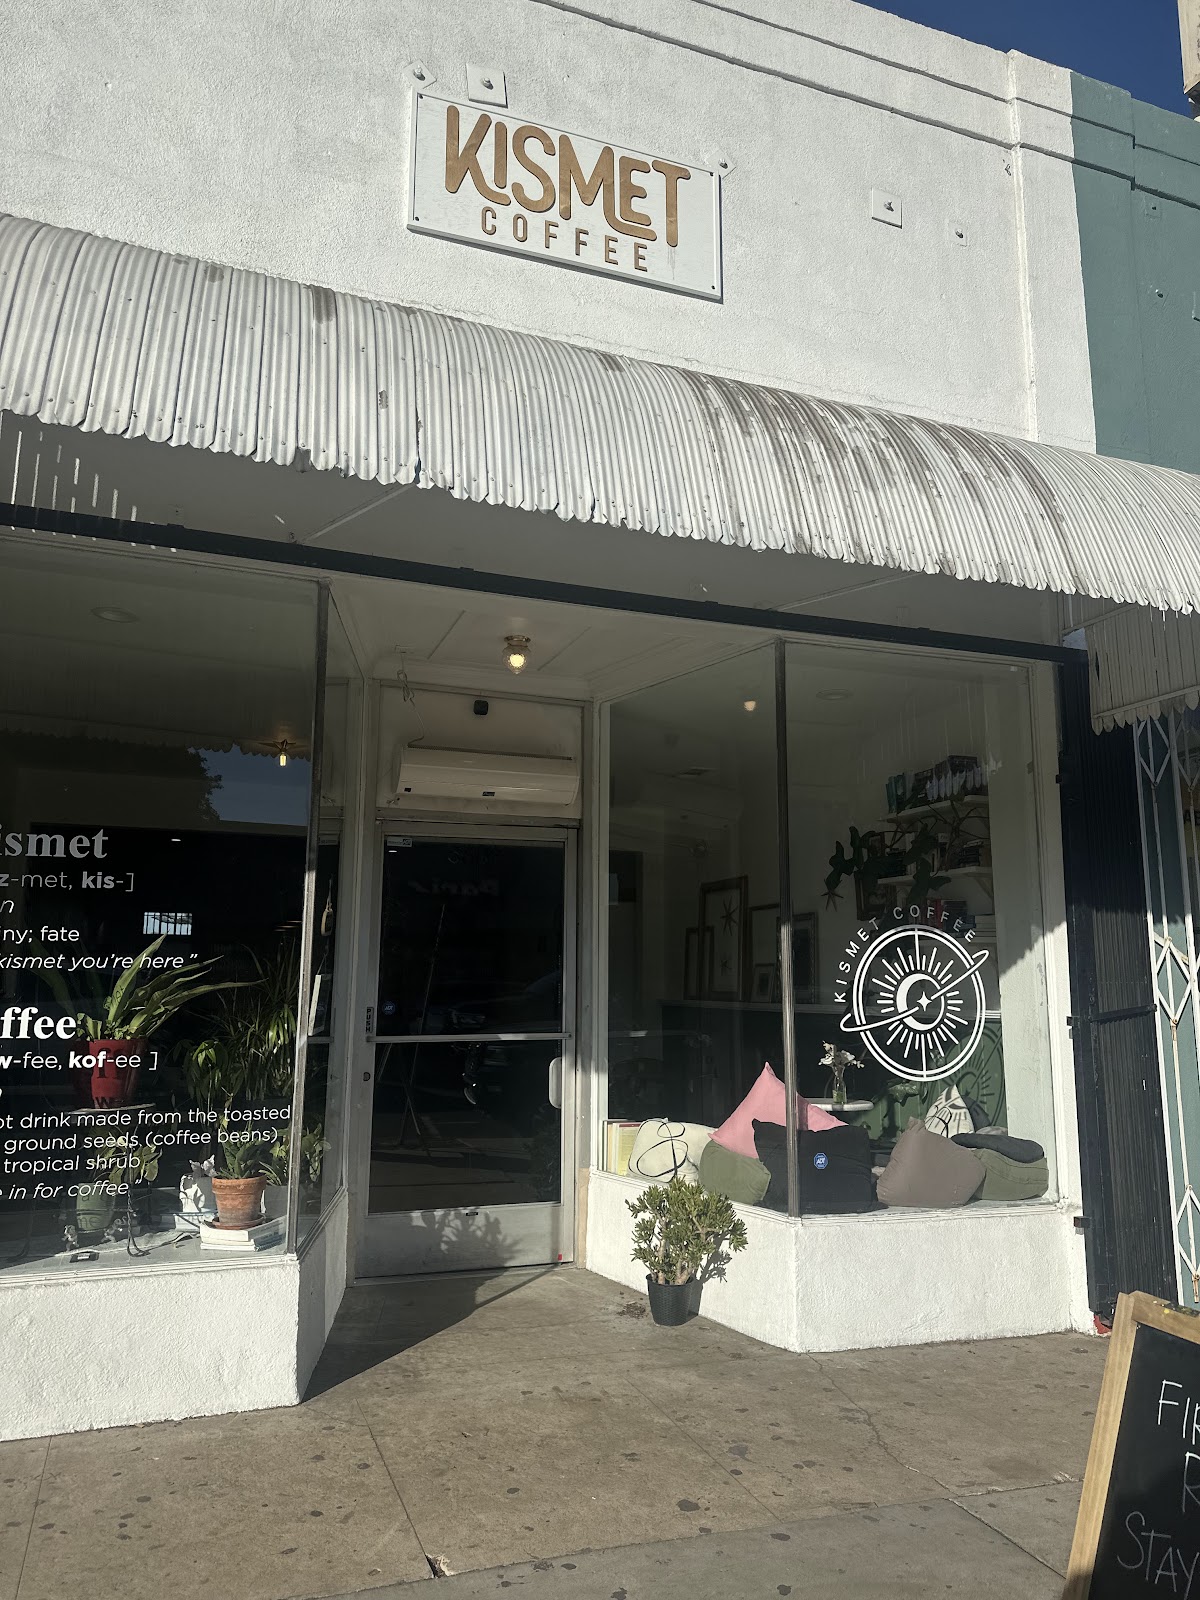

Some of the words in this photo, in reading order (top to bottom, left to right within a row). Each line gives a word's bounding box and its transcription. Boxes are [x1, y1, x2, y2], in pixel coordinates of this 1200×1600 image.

[445, 105, 691, 247] KISMET
[481, 206, 648, 272] COFFEE
[40, 926, 80, 942] fate
[834, 917, 880, 1003] KISMET
[892, 905, 976, 943] COFFEE
[0, 1006, 77, 1040] ffee
[20, 1112, 71, 1129] drink
[77, 1110, 131, 1127] made
[138, 1109, 181, 1124] from
[188, 1108, 217, 1123] the
[224, 1104, 291, 1122] toasted
[4, 1133, 77, 1155] ground
[83, 1131, 139, 1148] seeds
[146, 1129, 212, 1148] (coffee
[217, 1126, 278, 1144] beans)
[4, 1155, 80, 1175] tropical
[85, 1153, 141, 1170] shrub
[8, 1184, 27, 1200] in
[33, 1182, 63, 1199] for
[66, 1180, 129, 1197] coffee
[1117, 1510, 1200, 1600] STAY
